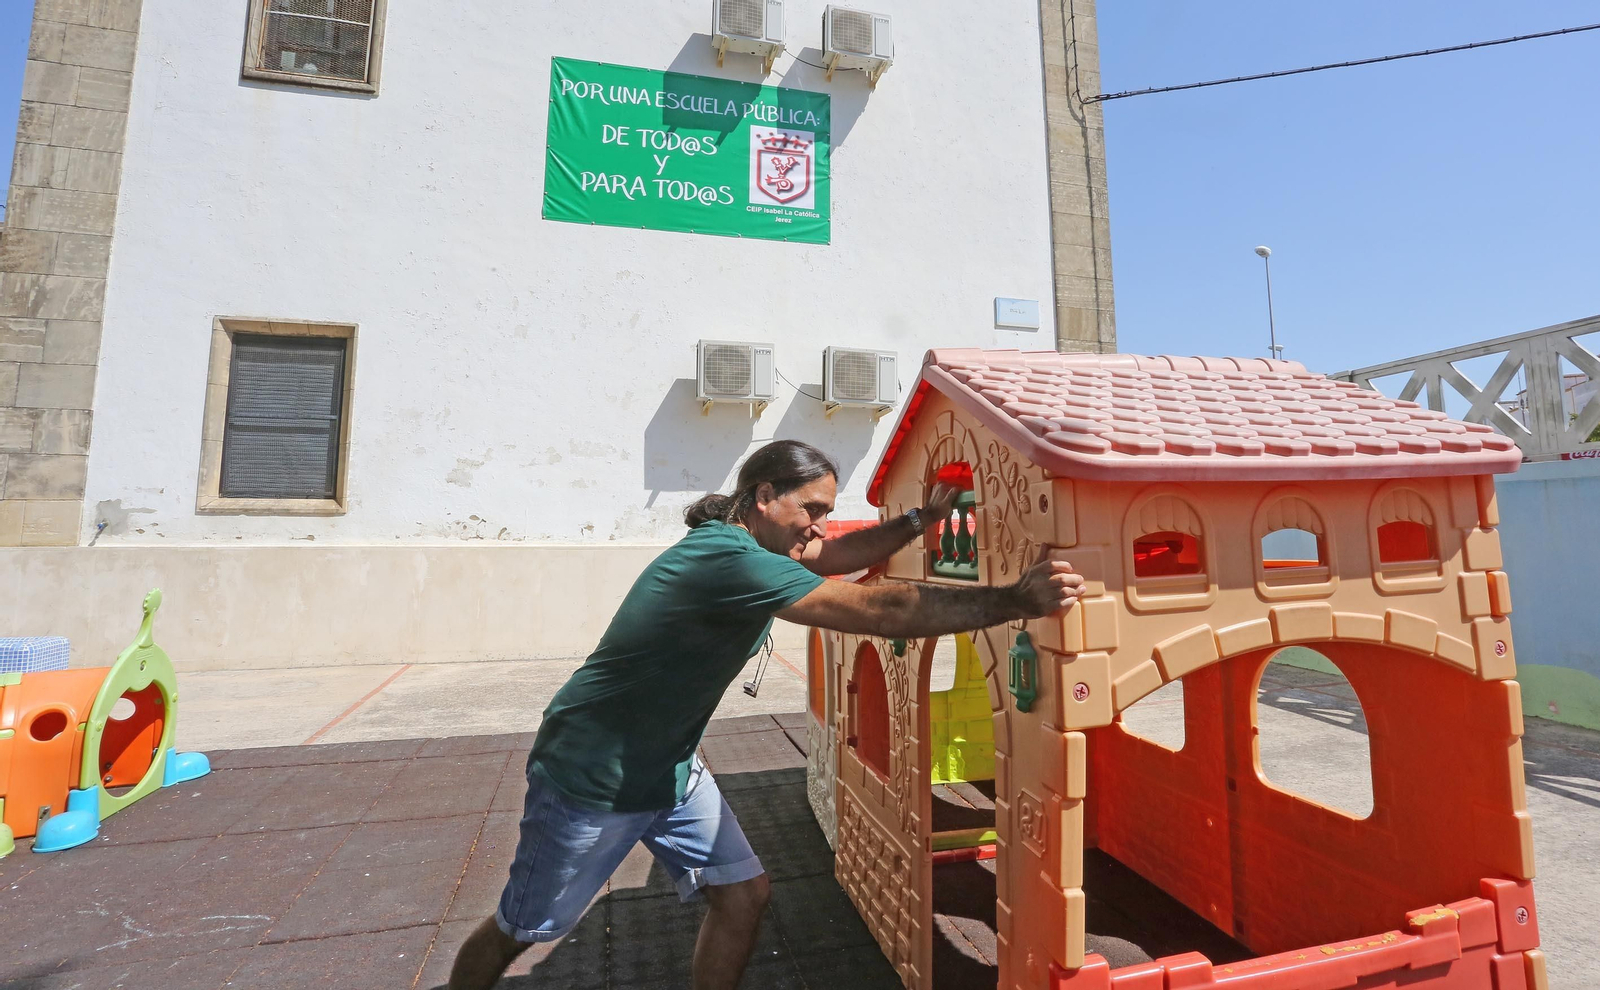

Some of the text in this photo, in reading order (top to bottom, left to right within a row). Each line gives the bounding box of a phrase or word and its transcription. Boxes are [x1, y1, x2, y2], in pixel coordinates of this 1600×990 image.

[561, 78, 820, 127] POR UNA ESCUELA PÚBLICA:
[602, 124, 718, 156] DE TOD@S
[580, 171, 735, 206] PARA TOD@S
[746, 205, 762, 213] CEIP
[764, 207, 784, 215] Isabel
[794, 210, 820, 219] Católica
[775, 216, 792, 224] Jerez
